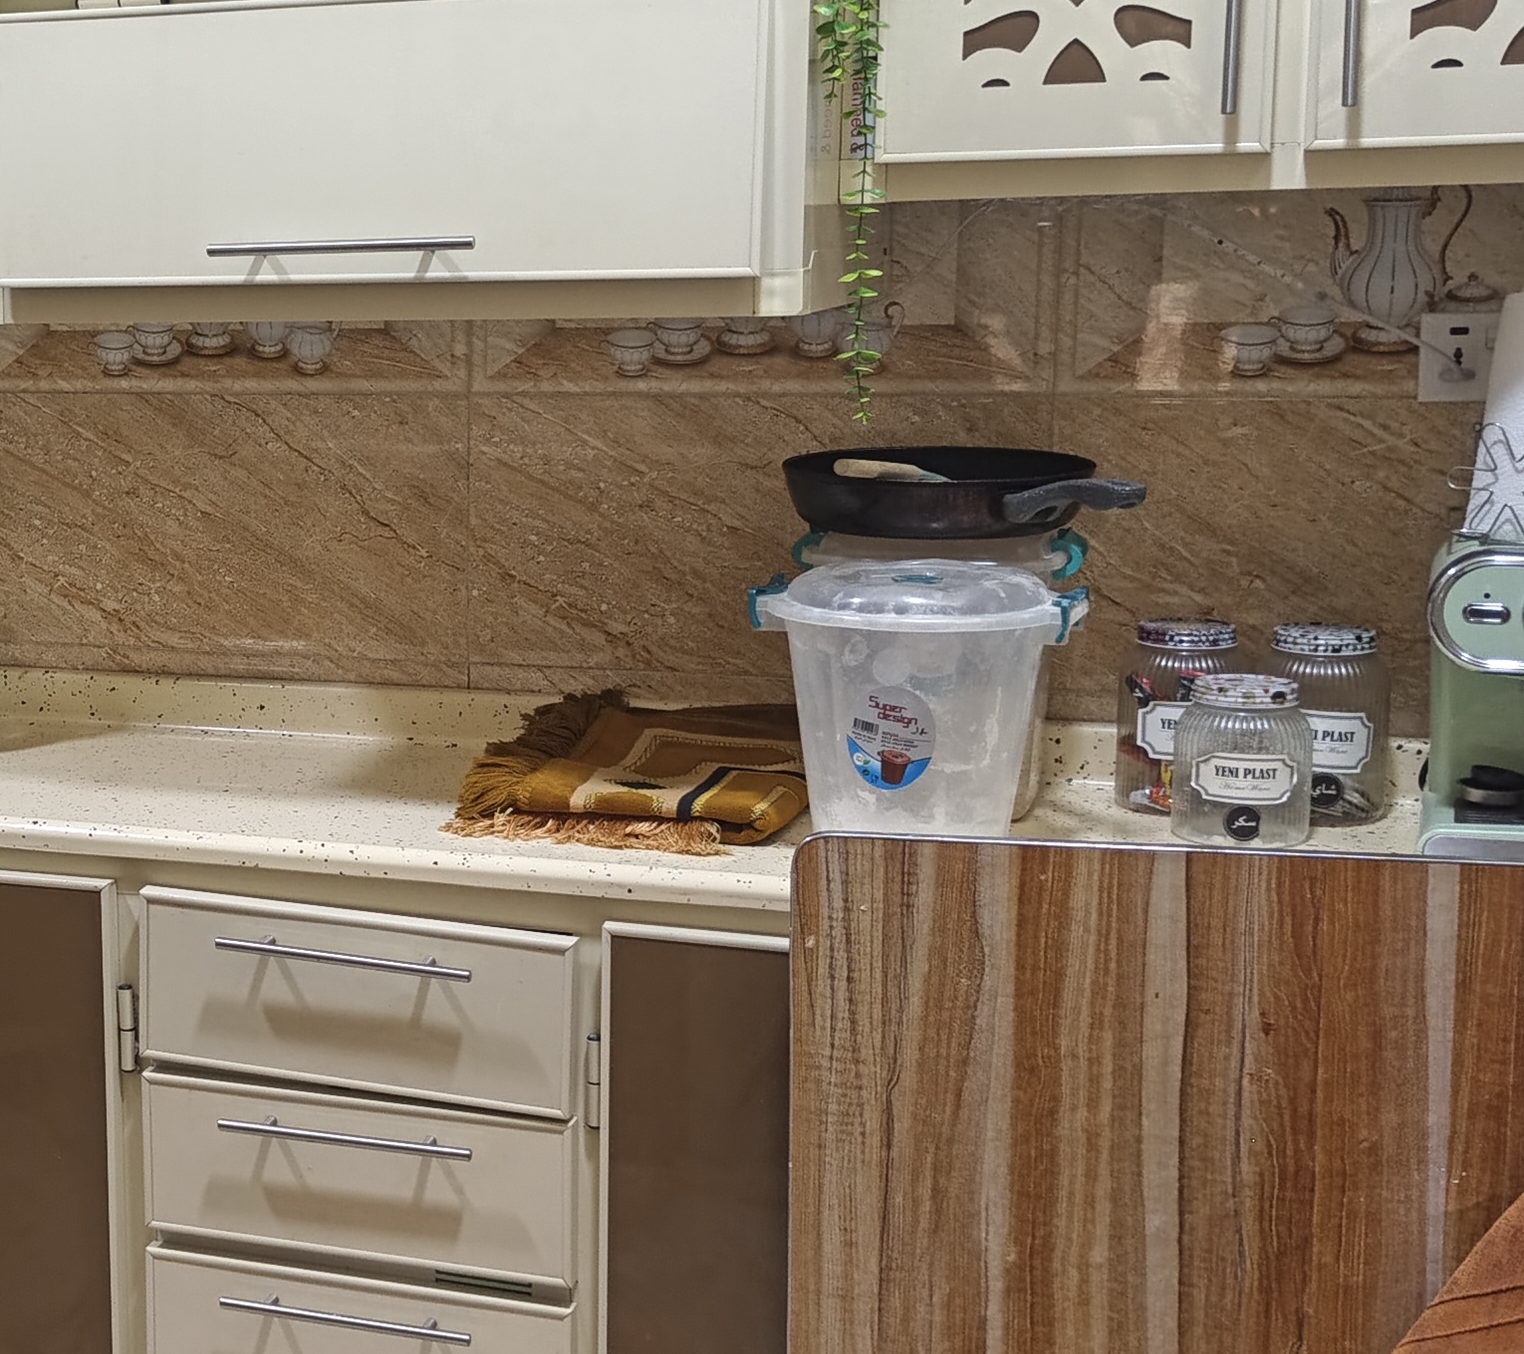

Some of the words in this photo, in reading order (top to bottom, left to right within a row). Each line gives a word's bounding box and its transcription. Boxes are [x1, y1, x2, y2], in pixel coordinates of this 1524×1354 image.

[868, 695, 908, 714] Super
[877, 711, 918, 728] design
[1160, 718, 1178, 730] YEN
[1321, 730, 1356, 742] PLAST
[1214, 764, 1240, 778] YENI
[1242, 767, 1278, 780] PLAST
[1311, 783, 1337, 798] شاي
[1230, 815, 1257, 829] سكر
